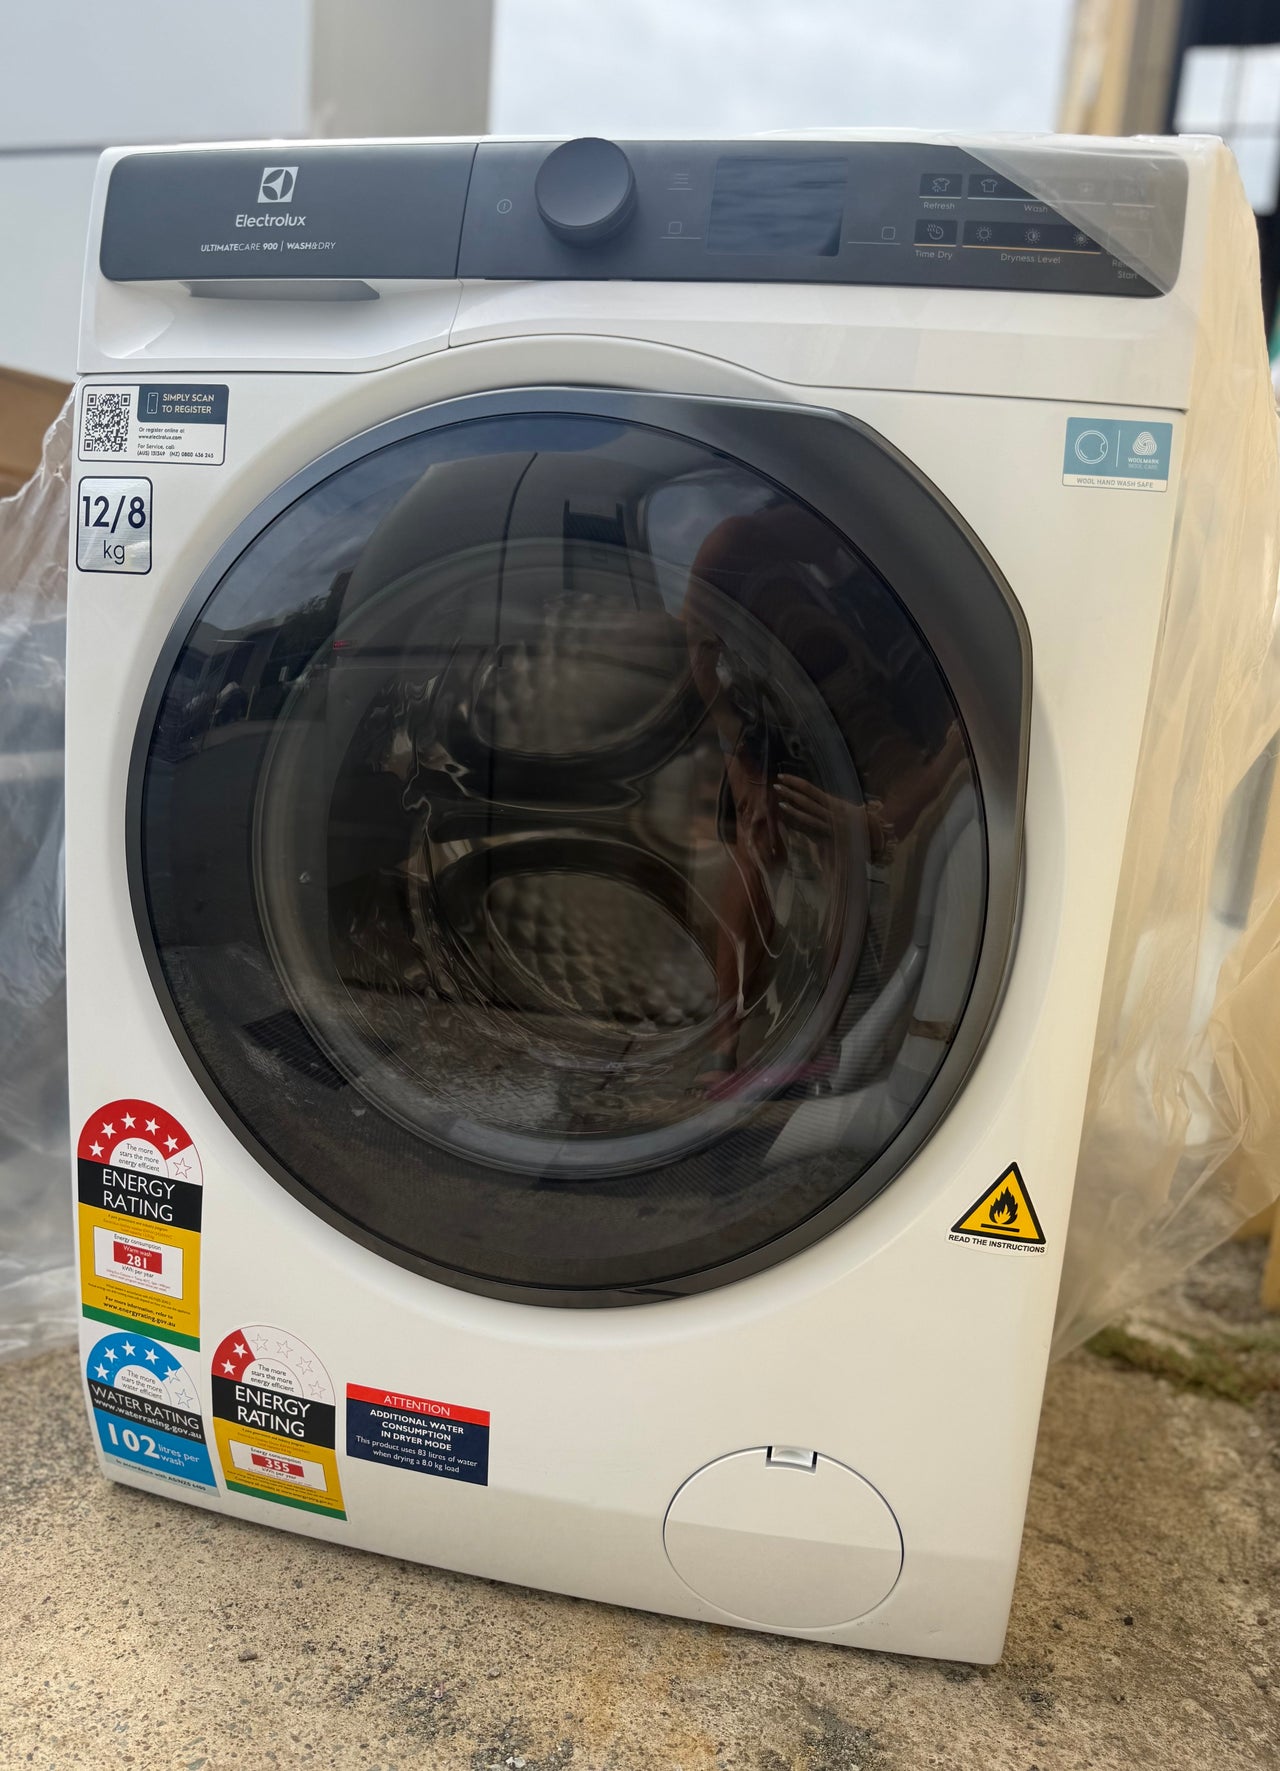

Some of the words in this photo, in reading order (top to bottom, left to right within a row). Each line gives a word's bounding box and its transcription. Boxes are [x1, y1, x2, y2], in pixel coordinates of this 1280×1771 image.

[923, 201, 955, 210] Refresh
[1024, 204, 1048, 213] Wash
[235, 213, 307, 228] Electrolux
[200, 243, 262, 252] ULTIMATECARE
[262, 242, 279, 251] 900
[286, 241, 336, 250] WASH&DRY
[915, 250, 936, 259] Time
[938, 251, 953, 260] Dry
[1000, 253, 1035, 263] Dryness
[1037, 255, 1061, 264] Level
[1117, 270, 1138, 280] Start
[162, 393, 191, 402] SIMPLY
[191, 394, 215, 402] SCAN
[162, 405, 173, 413] TO
[174, 405, 212, 414] REGISTER
[1077, 477, 1096, 485] WOOL
[1097, 478, 1116, 486] HAND
[83, 495, 146, 533] 12/8
[103, 540, 125, 565] kg
[138, 1147, 153, 1155] more
[119, 1158, 137, 1168] energy
[138, 1161, 160, 1172] efficient
[144, 1156, 159, 1164] more
[102, 1168, 176, 1200] ENERGY
[103, 1190, 174, 1222] RATING
[114, 1233, 130, 1244] Energy
[130, 1239, 162, 1251] consumption
[124, 1245, 139, 1254] Warm
[948, 1234, 971, 1243] READ
[972, 1238, 988, 1246] THE
[988, 1240, 1045, 1254] INSTRUCTIONS
[126, 1253, 147, 1269] 281
[127, 1370, 139, 1378] The
[140, 1375, 156, 1384] more
[258, 1363, 270, 1373] The
[271, 1368, 287, 1376] more
[250, 1377, 270, 1388] energy
[271, 1381, 294, 1392] efficient
[251, 1370, 265, 1379] stars
[266, 1373, 276, 1381] the
[277, 1377, 293, 1385] more
[147, 1384, 162, 1393] more
[91, 1383, 143, 1412] WATER
[144, 1402, 200, 1430] RATING
[235, 1384, 311, 1418] ENERGY
[383, 1395, 451, 1417] ATTENTION
[94, 1398, 202, 1440] www.waterrating.gov.au
[237, 1405, 305, 1438] RATING
[370, 1409, 428, 1427] ADDITIONAL
[429, 1421, 465, 1434] WATER
[381, 1421, 452, 1442] CONSUMPTION
[108, 1422, 161, 1459] 102
[158, 1443, 181, 1457] litres
[183, 1453, 200, 1463] per
[381, 1430, 391, 1439] IN
[393, 1433, 423, 1446] DRYER
[424, 1440, 452, 1451] MODE
[356, 1435, 371, 1445] This
[371, 1440, 400, 1451] product
[400, 1447, 416, 1455] uses
[417, 1448, 427, 1457] 83
[428, 1451, 446, 1461] litres
[456, 1458, 478, 1467] water
[160, 1454, 185, 1467] wash
[264, 1458, 290, 1473] 355
[372, 1449, 391, 1459] when
[393, 1454, 415, 1466] drying
[421, 1458, 433, 1467] 8.0
[434, 1462, 443, 1471] kg
[444, 1464, 460, 1473] load
